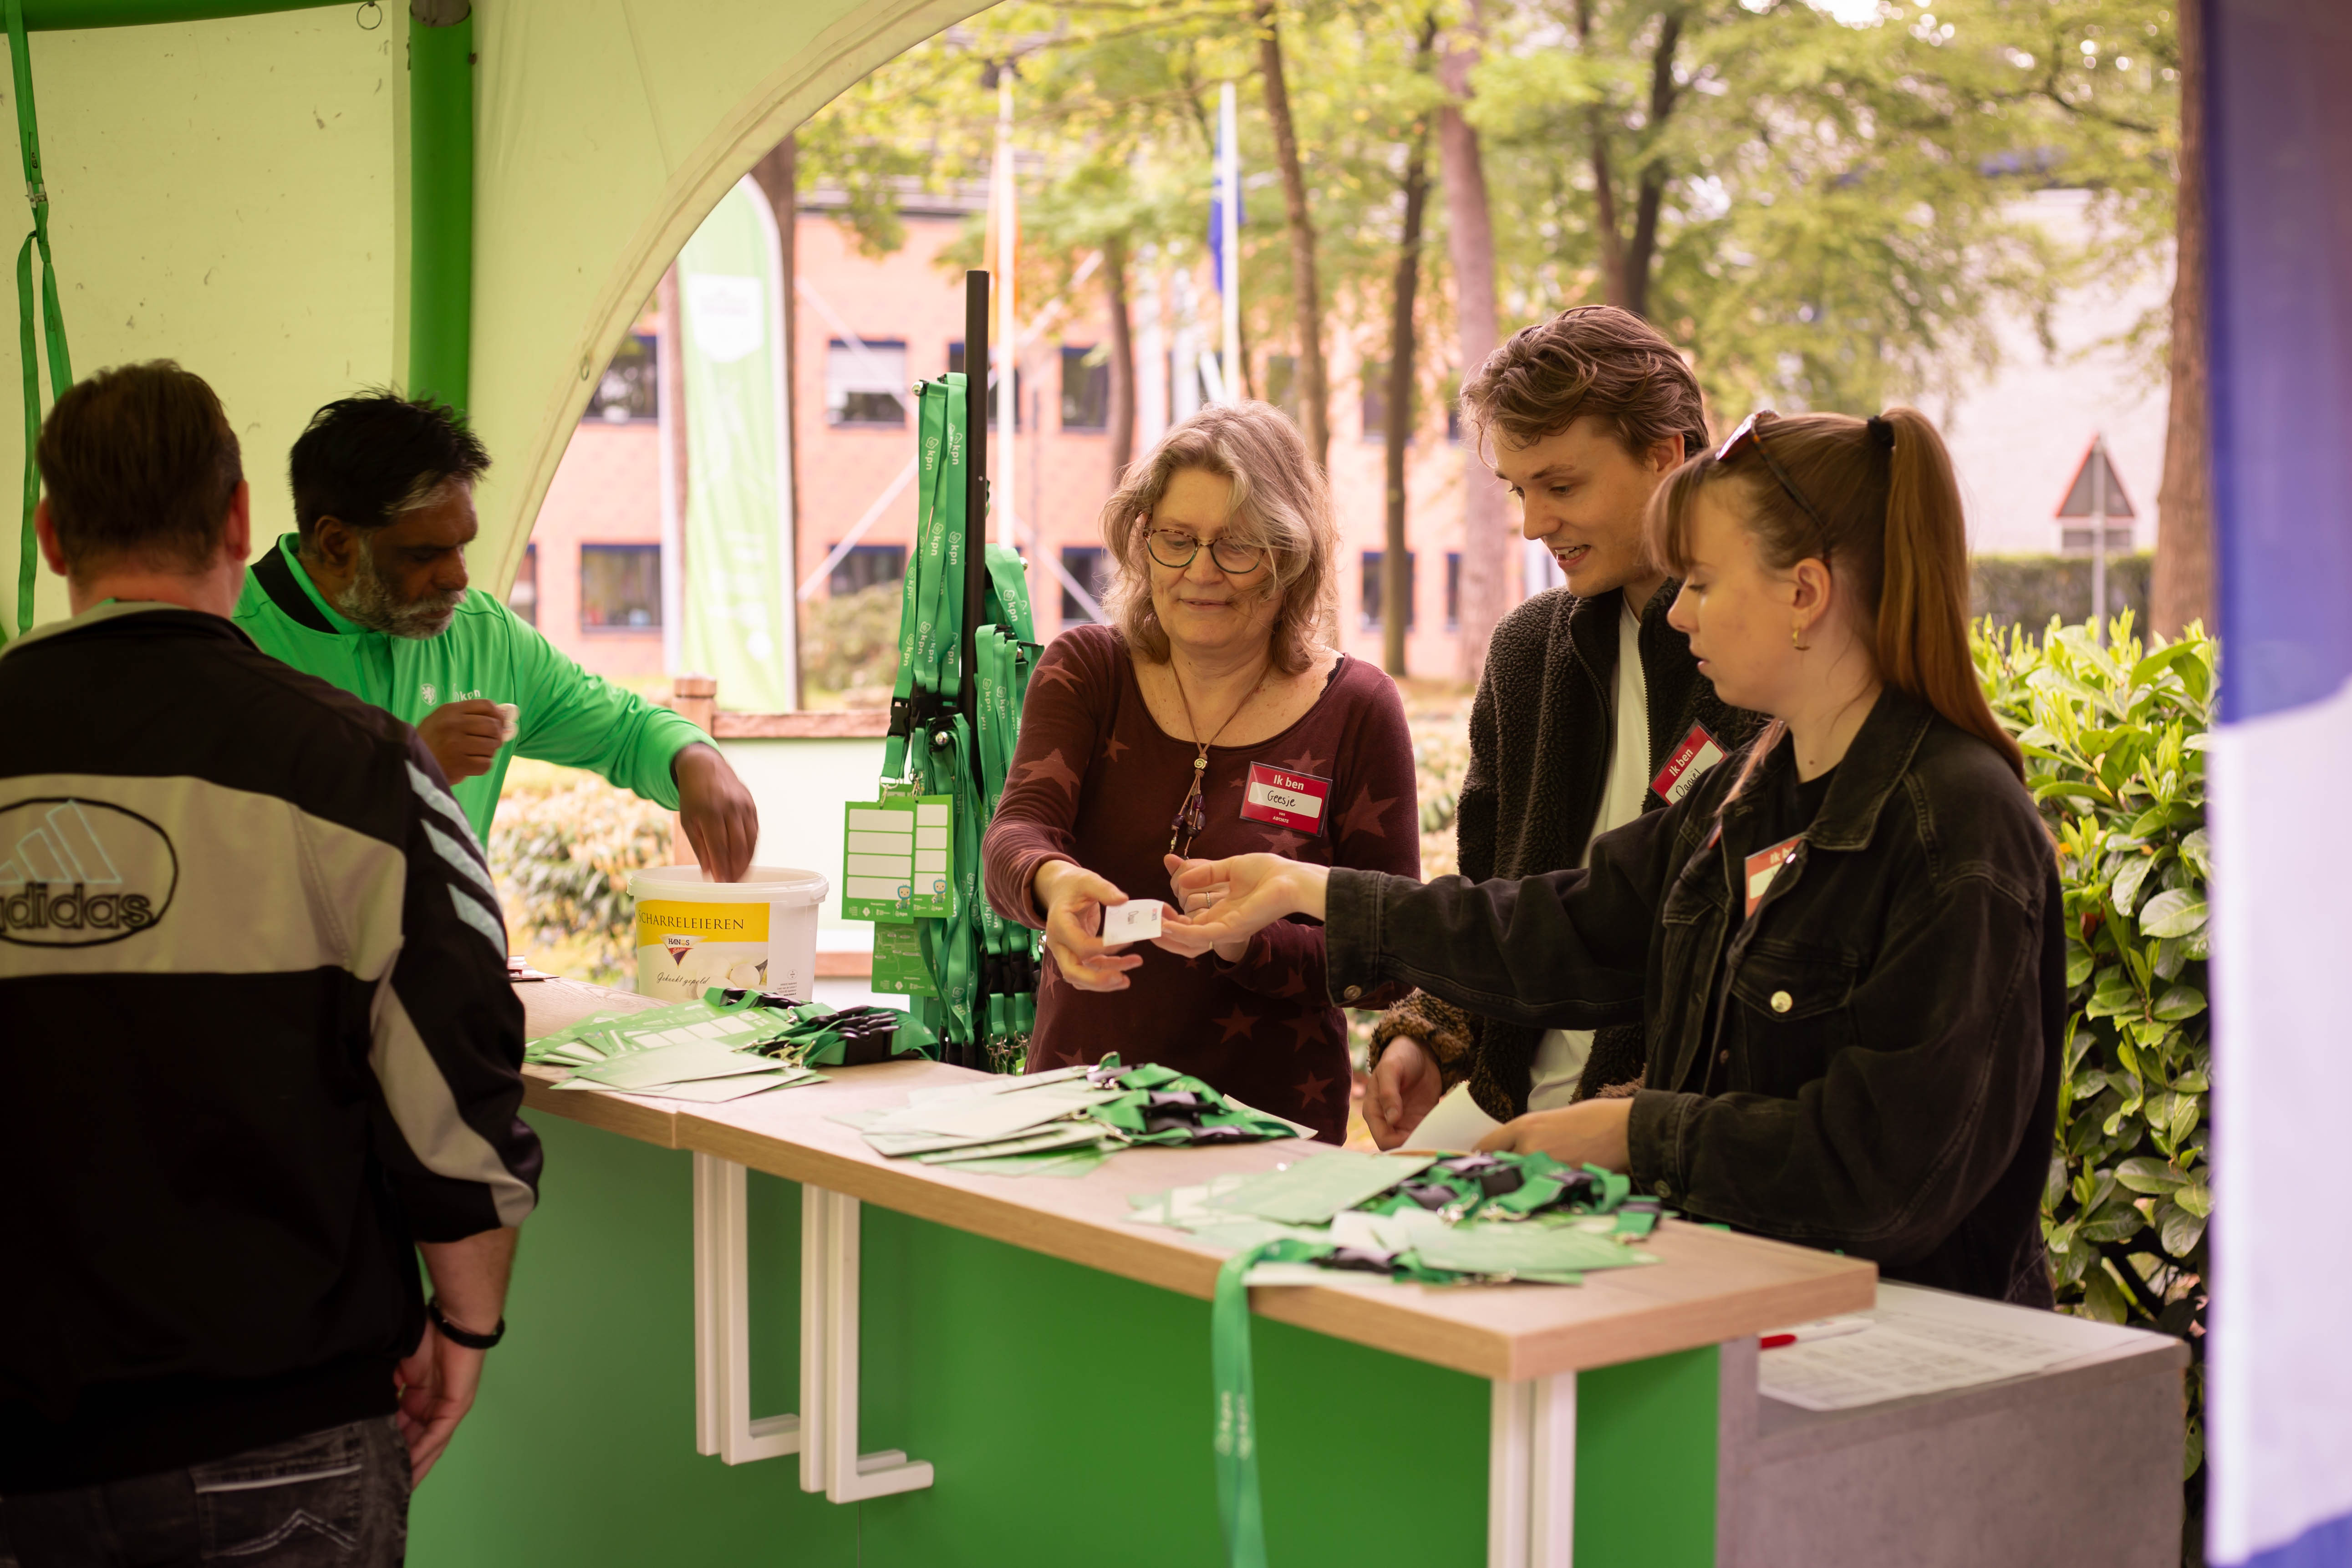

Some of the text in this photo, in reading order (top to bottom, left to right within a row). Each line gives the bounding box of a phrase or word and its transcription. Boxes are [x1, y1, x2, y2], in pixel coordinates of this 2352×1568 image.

[925, 450, 936, 470] kpn
[951, 445, 961, 465] kpn
[931, 536, 941, 556] kpn
[949, 545, 959, 565] kpn
[1008, 602, 1018, 621] kpn
[918, 635, 927, 654] kpn
[928, 643, 936, 662] kpn
[904, 647, 913, 666] kpn
[1669, 749, 1693, 777] Ik ben
[1273, 775, 1304, 790] Ik ben
[1268, 790, 1296, 807] Geesje
[1770, 851, 1781, 864] Ik
[638, 909, 744, 930] SCHARRELEIEREN
[657, 972, 711, 987] Gekookt gepeld
